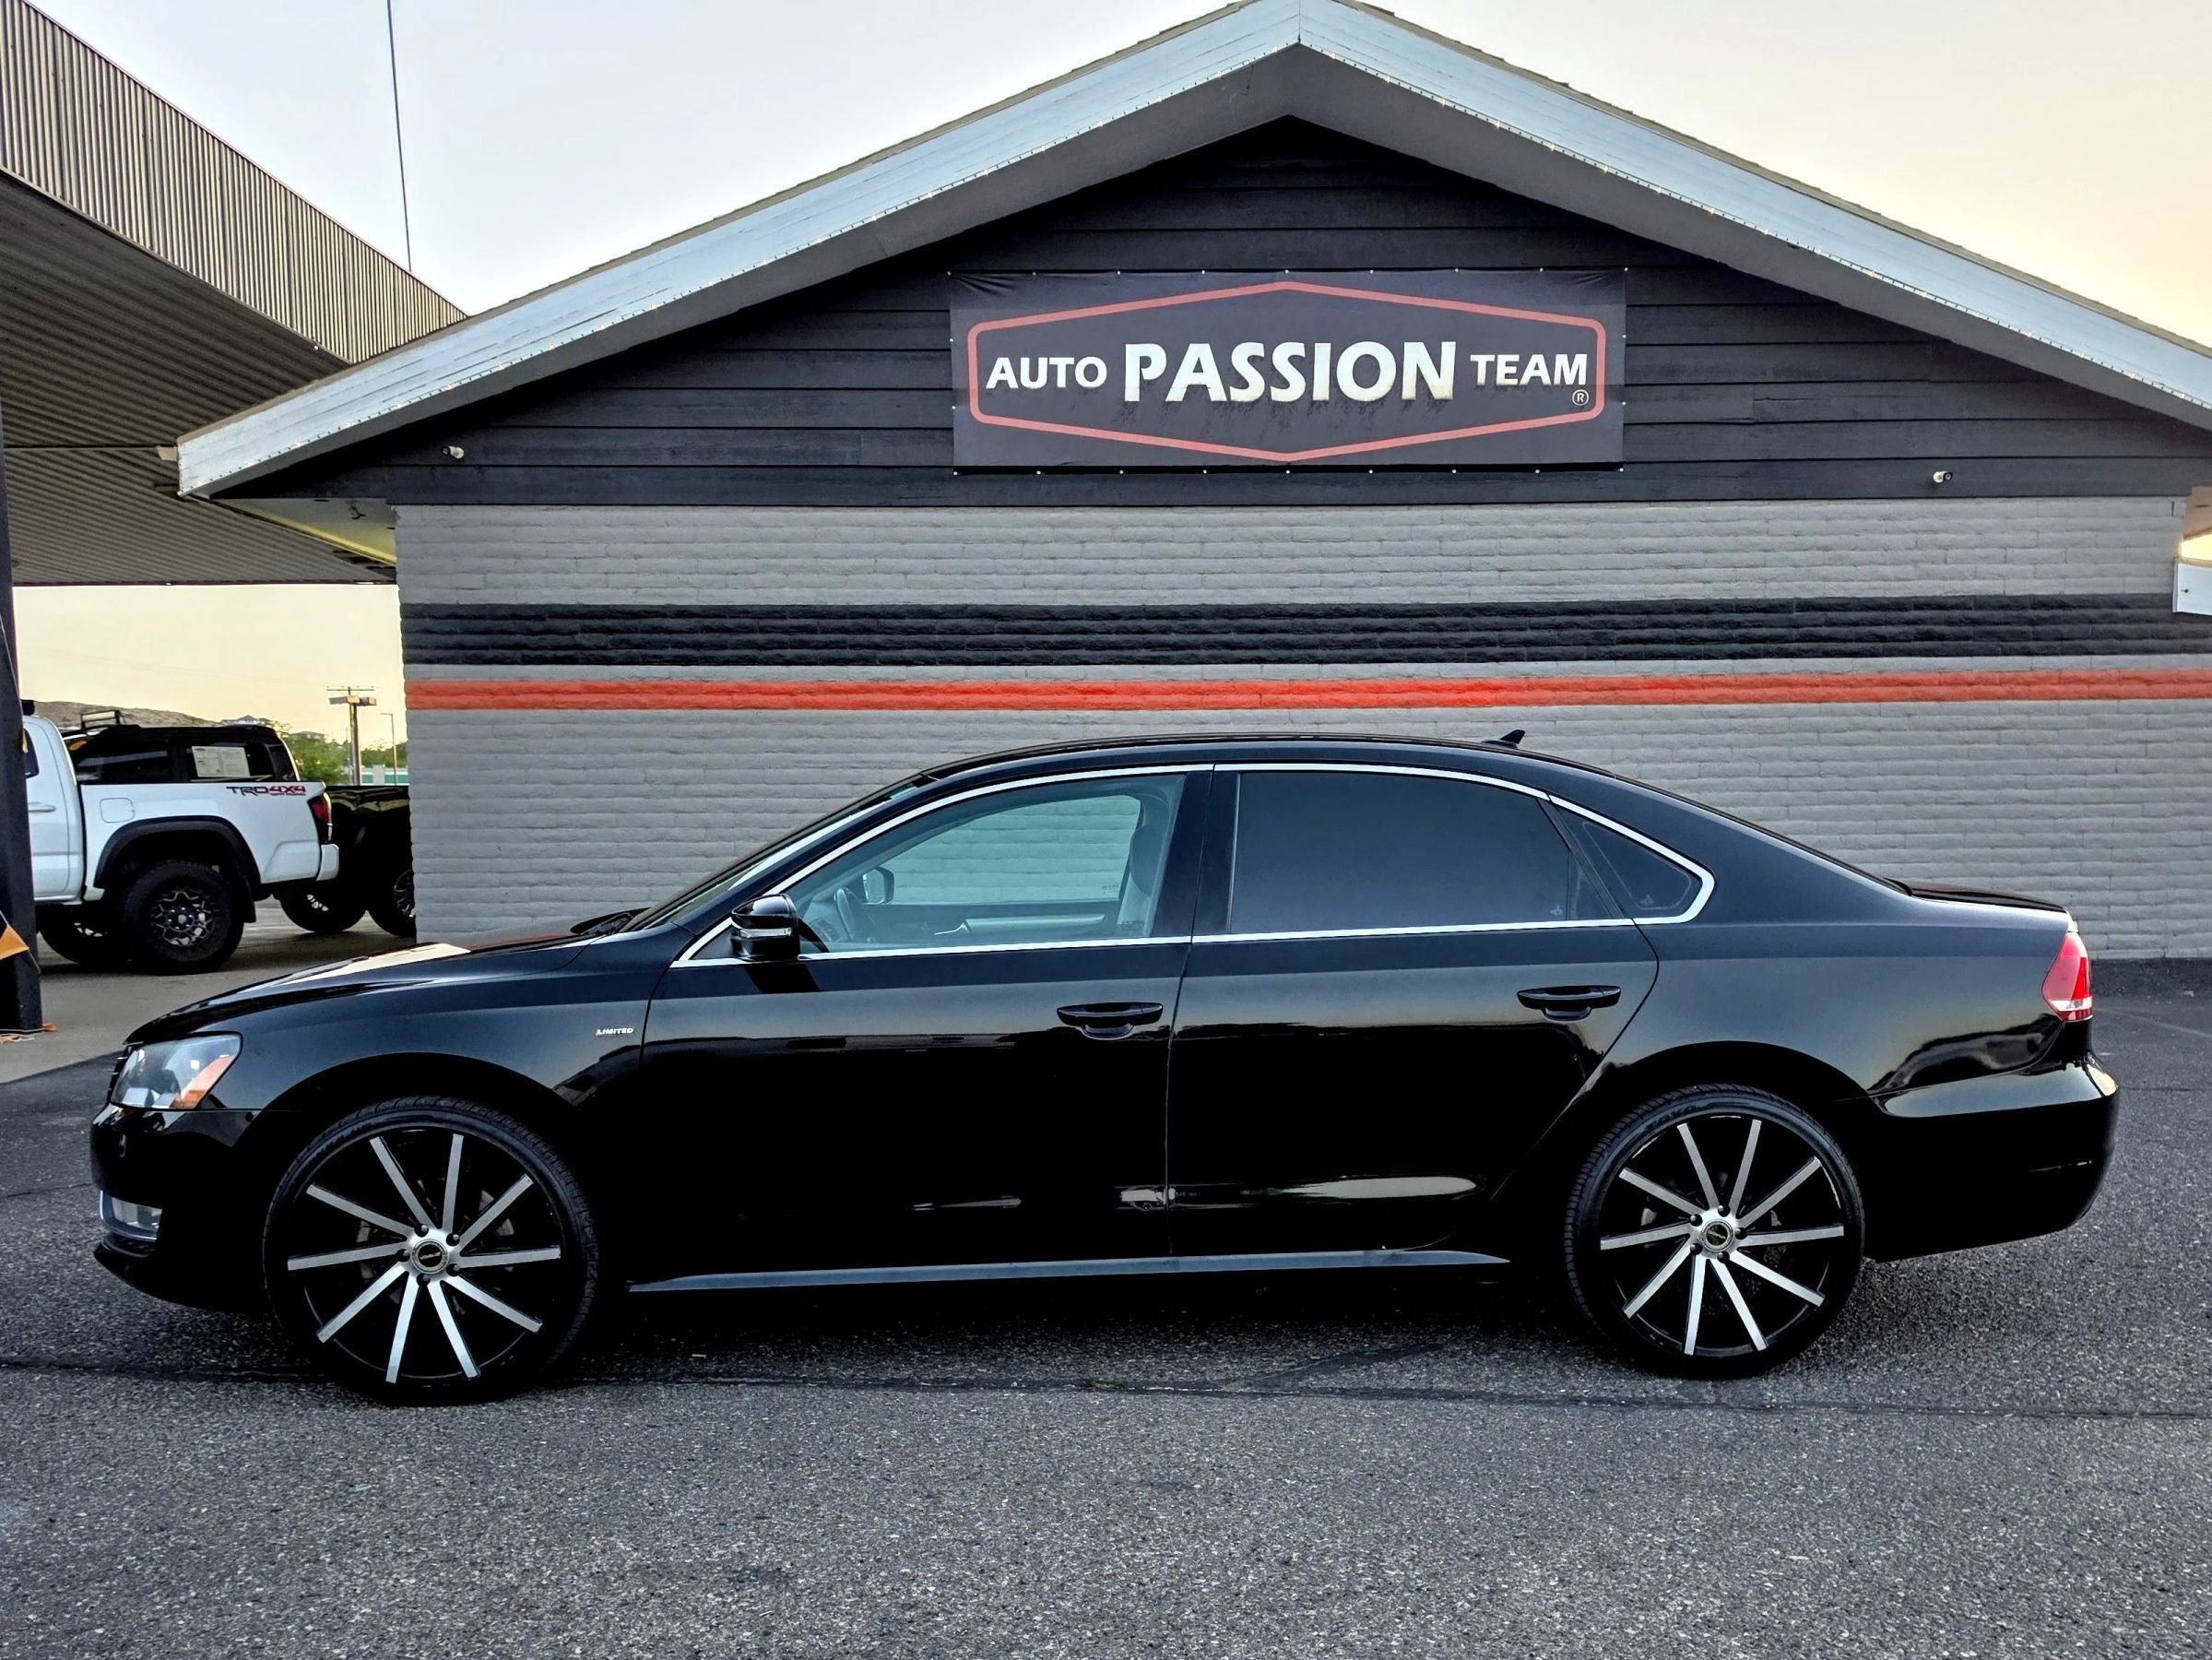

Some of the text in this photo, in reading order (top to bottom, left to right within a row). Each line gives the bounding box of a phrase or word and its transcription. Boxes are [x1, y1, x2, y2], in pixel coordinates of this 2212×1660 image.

[986, 341, 1588, 403] AUTO PASSION TEAM
[596, 1027, 633, 1037] LIMITED
